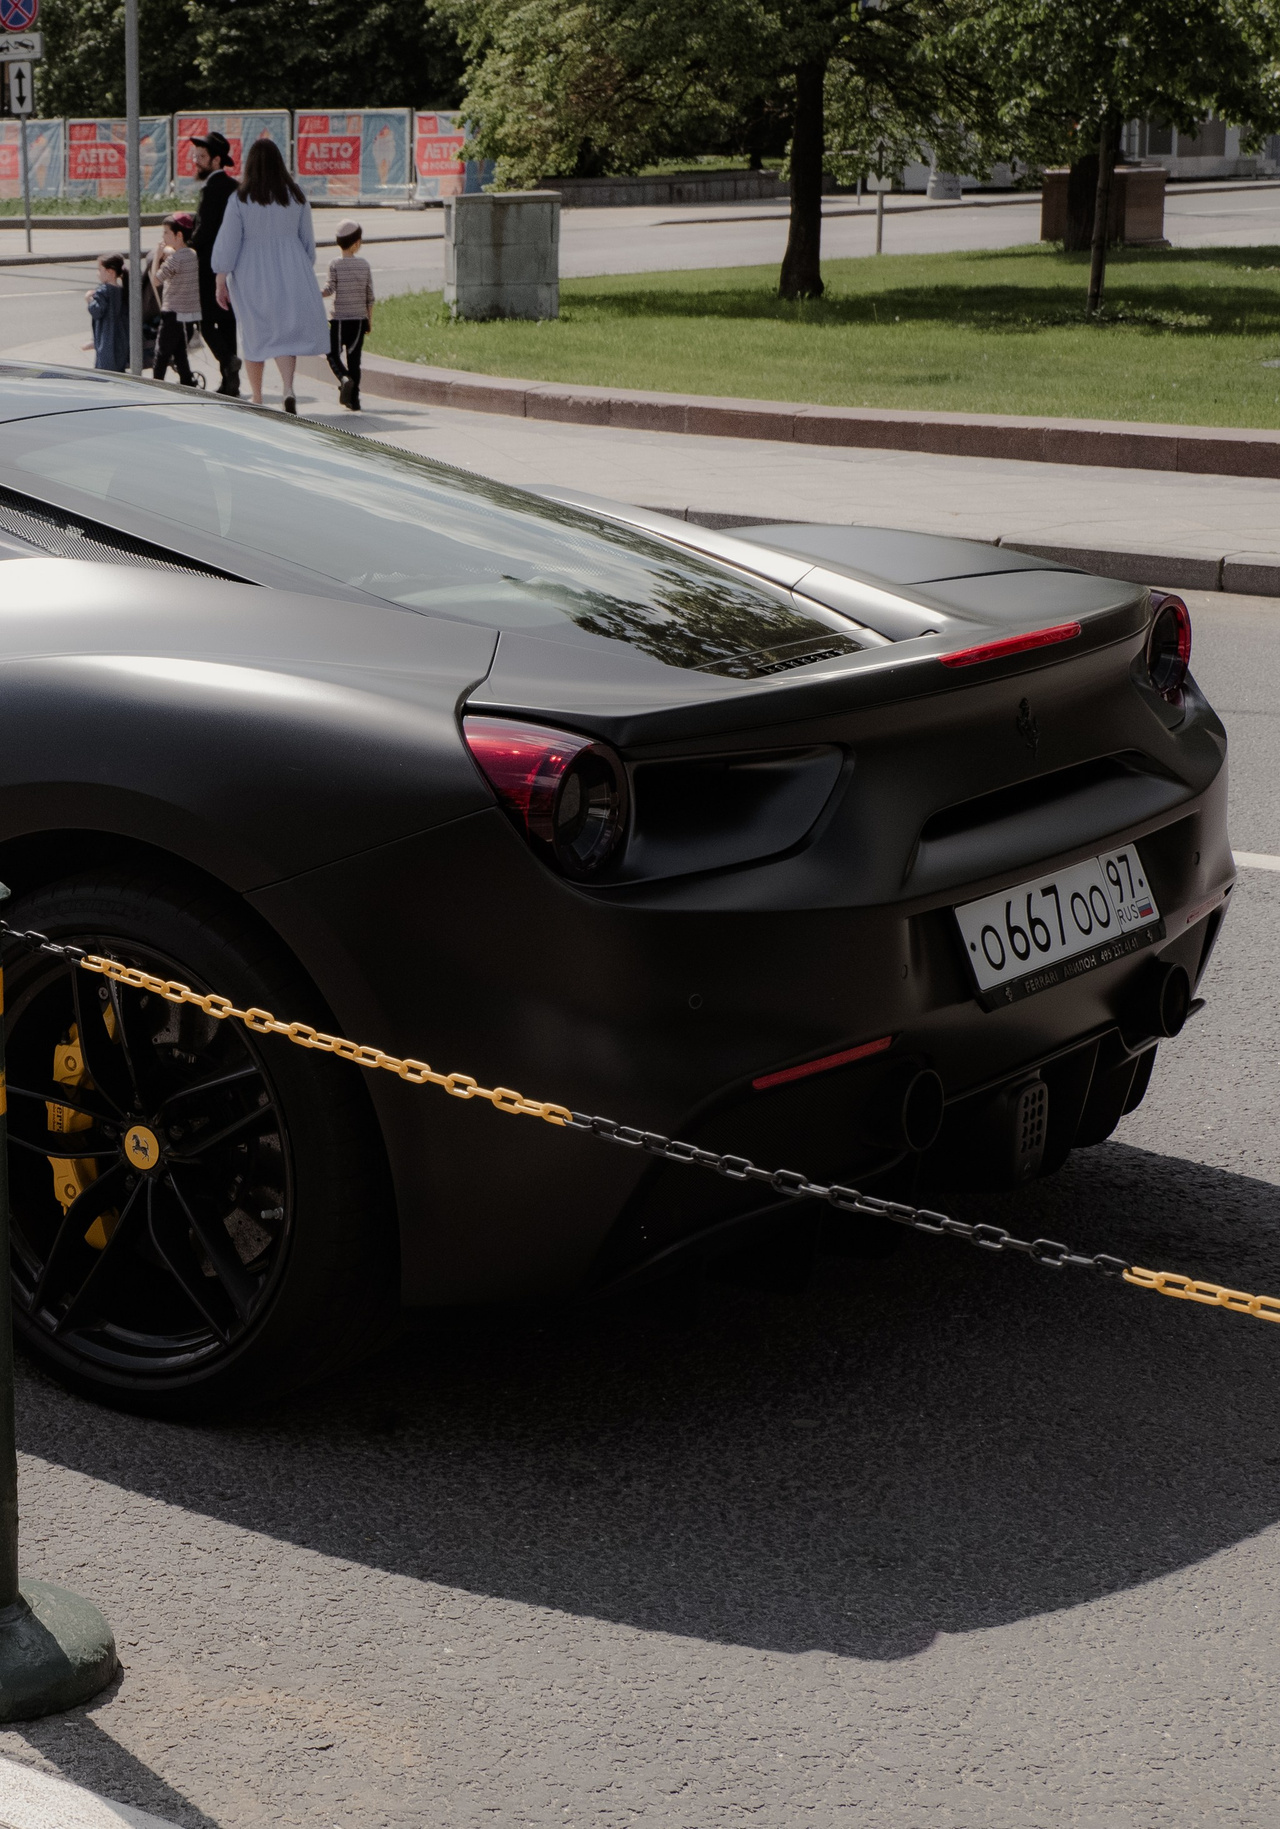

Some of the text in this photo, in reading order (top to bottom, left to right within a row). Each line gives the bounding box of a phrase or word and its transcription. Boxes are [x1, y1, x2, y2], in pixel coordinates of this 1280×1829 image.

[77, 148, 119, 164] ЛЕТО
[306, 142, 353, 159] ЛЕТО
[1105, 854, 1136, 904] 97
[1116, 903, 1139, 925] RUS
[1023, 970, 1059, 993] FERRARI
